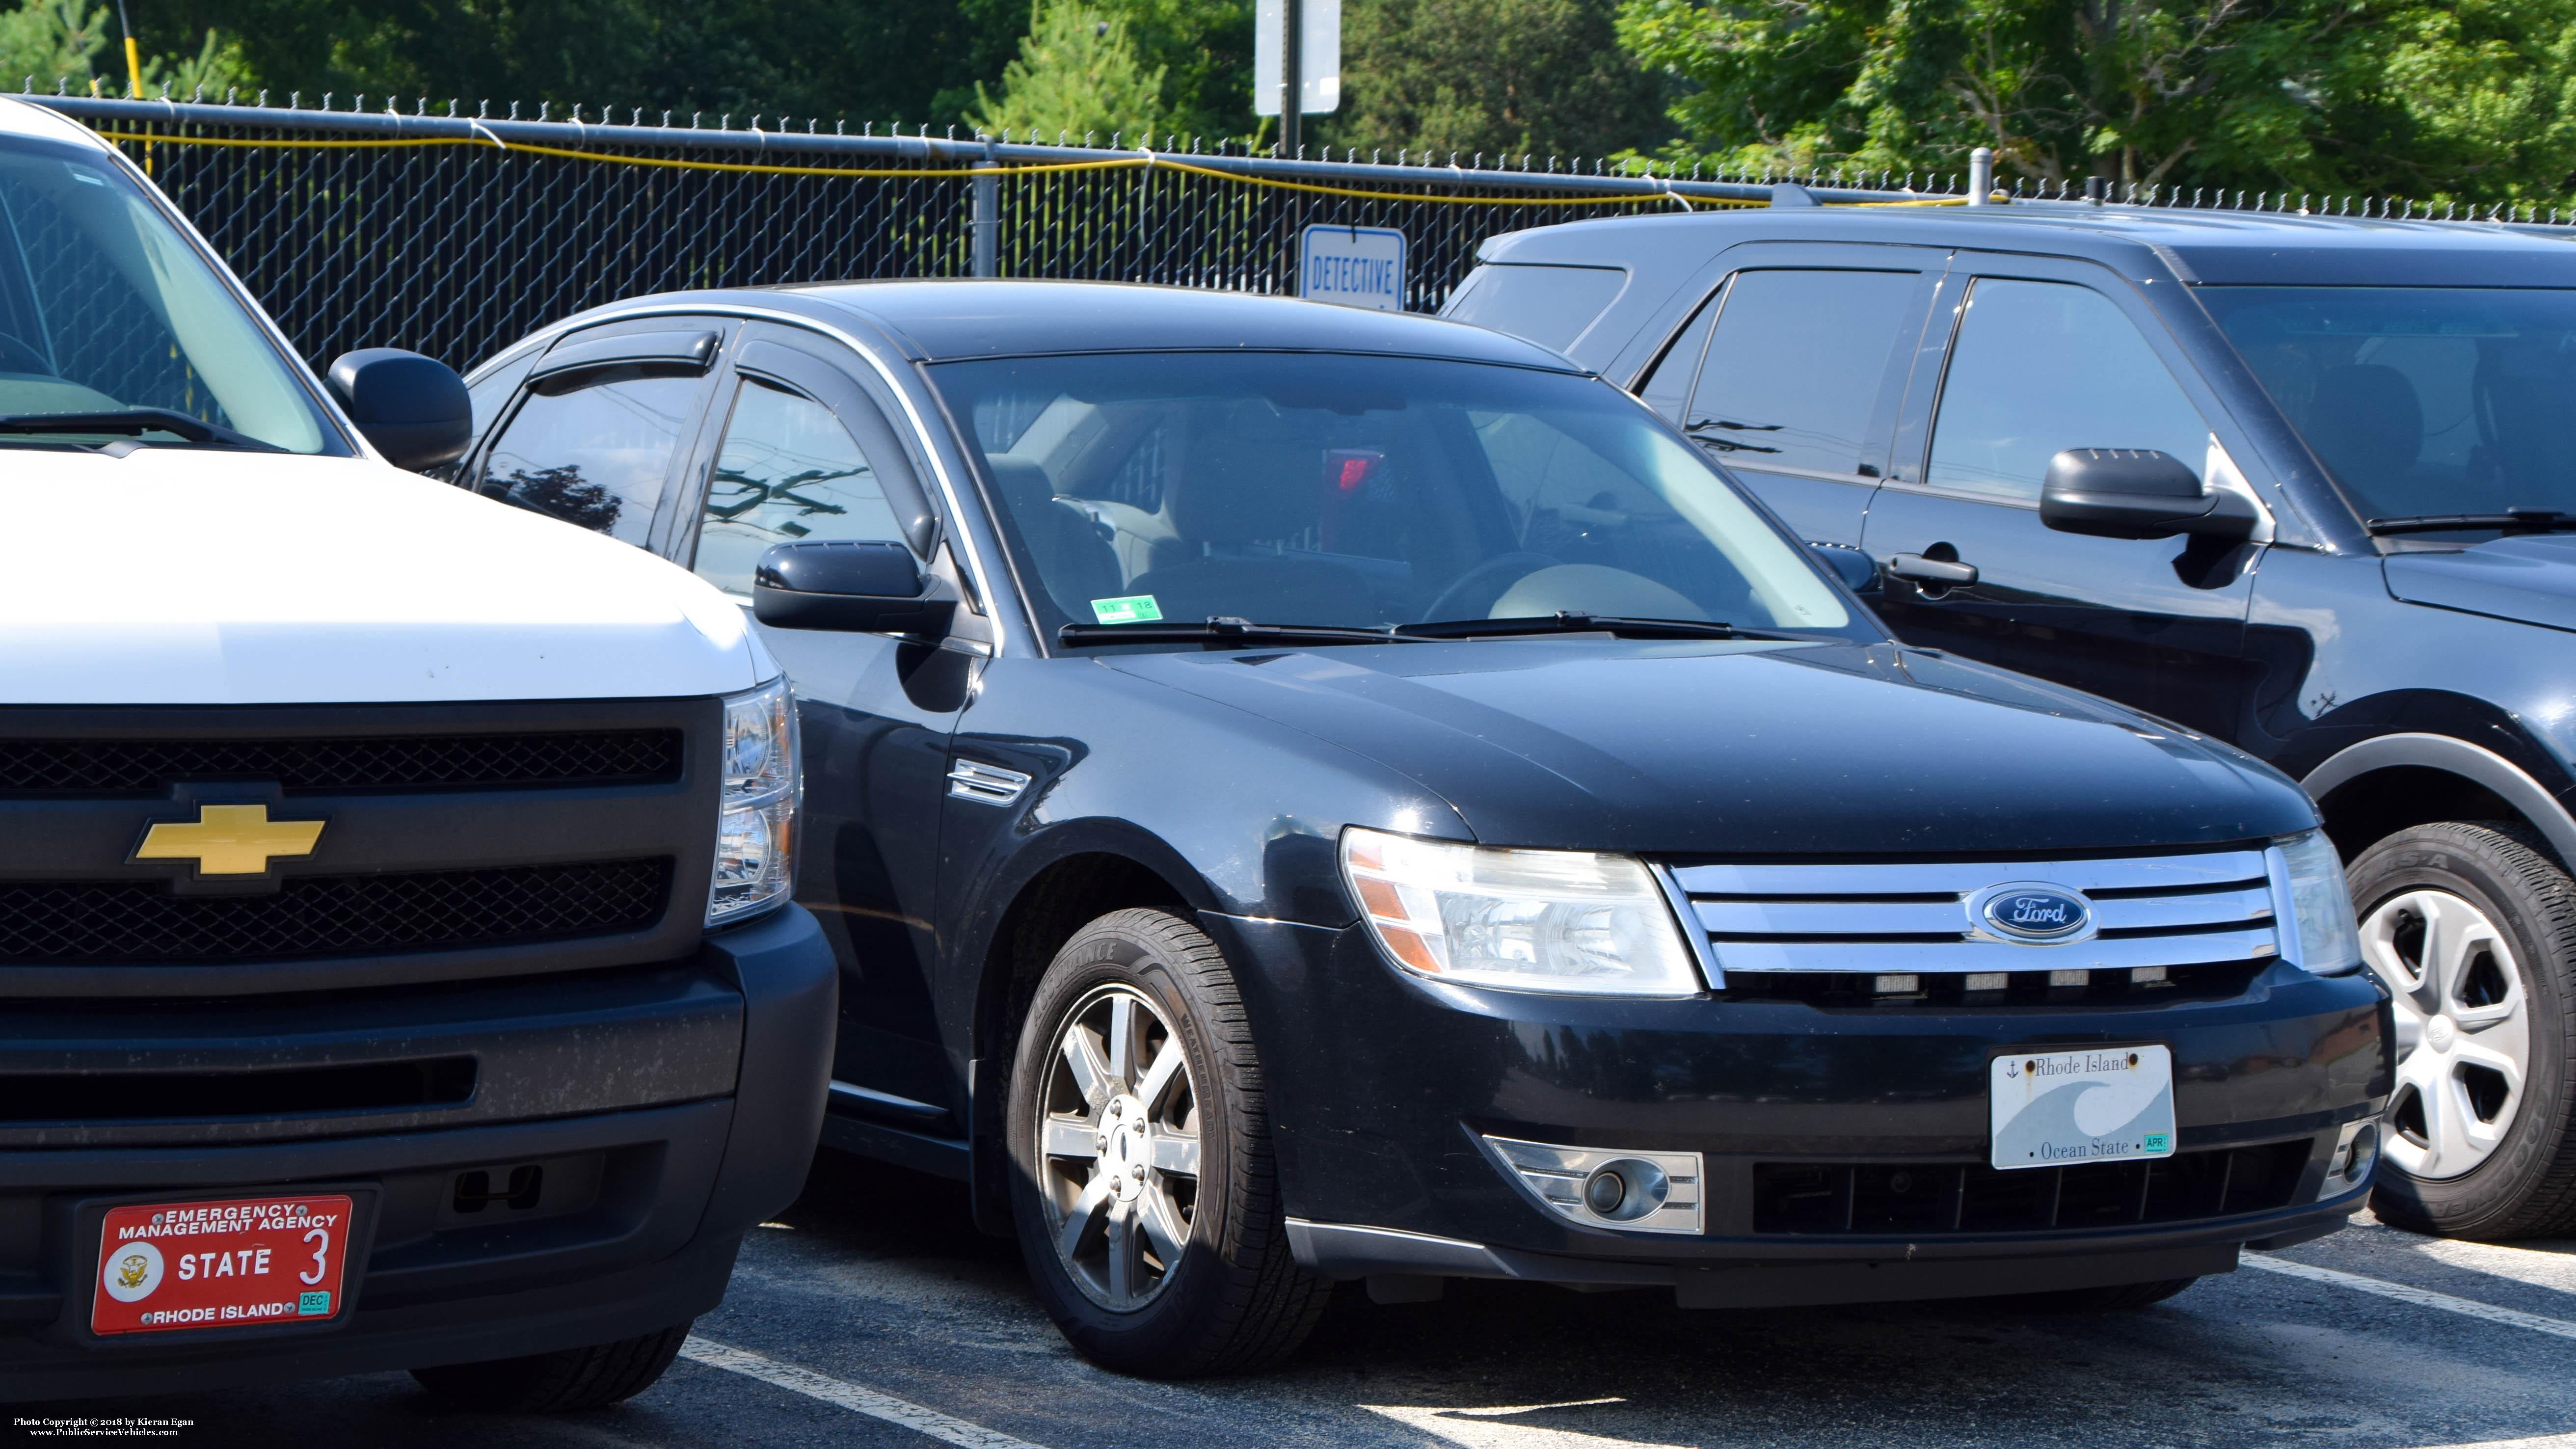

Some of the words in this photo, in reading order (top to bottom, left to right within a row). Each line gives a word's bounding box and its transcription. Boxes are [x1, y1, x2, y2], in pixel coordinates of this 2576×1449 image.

[1313, 256, 1393, 294] DETECTIVE
[1137, 601, 1152, 609] 18
[2012, 897, 2066, 922] Ford
[1034, 942, 1117, 1027] ASSURANCE
[2035, 1058, 2080, 1076] Rhode
[2085, 1052, 2129, 1073] Island
[2041, 1141, 2086, 1159] Ocean
[2092, 1138, 2129, 1156] State
[2147, 1138, 2163, 1147] APR
[165, 1204, 295, 1224] EMERGENCY
[118, 1219, 253, 1239] MANAGEMENT
[258, 1215, 338, 1230] AGENCY
[178, 1249, 271, 1280] STATE
[299, 1229, 329, 1285] 3
[303, 1295, 322, 1305] DEC
[153, 1306, 215, 1324] RHODE
[220, 1303, 284, 1319] ISLAND
